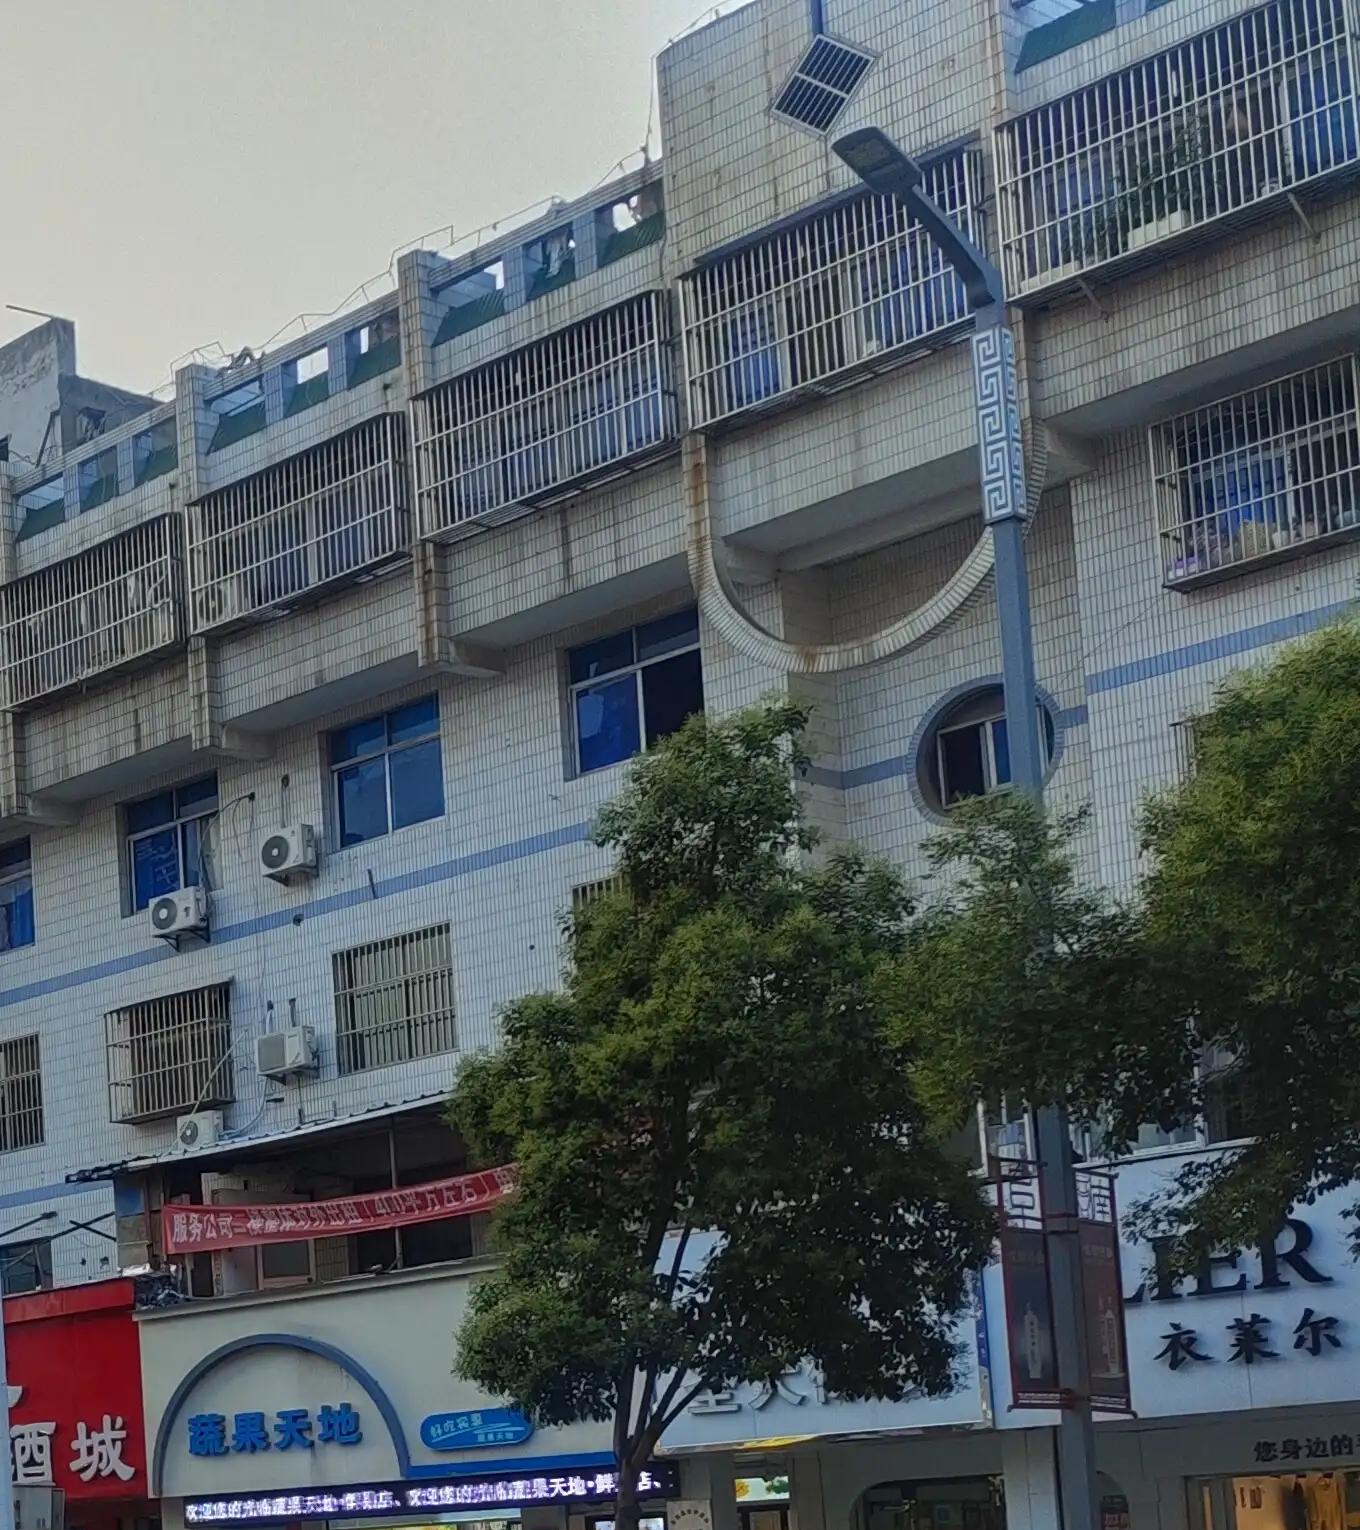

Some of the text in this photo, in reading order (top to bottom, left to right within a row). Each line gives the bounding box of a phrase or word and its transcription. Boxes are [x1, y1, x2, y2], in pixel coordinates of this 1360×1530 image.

[1153, 1307, 1343, 1370] 衣莱尔
[187, 1402, 364, 1457] 蔬果天地
